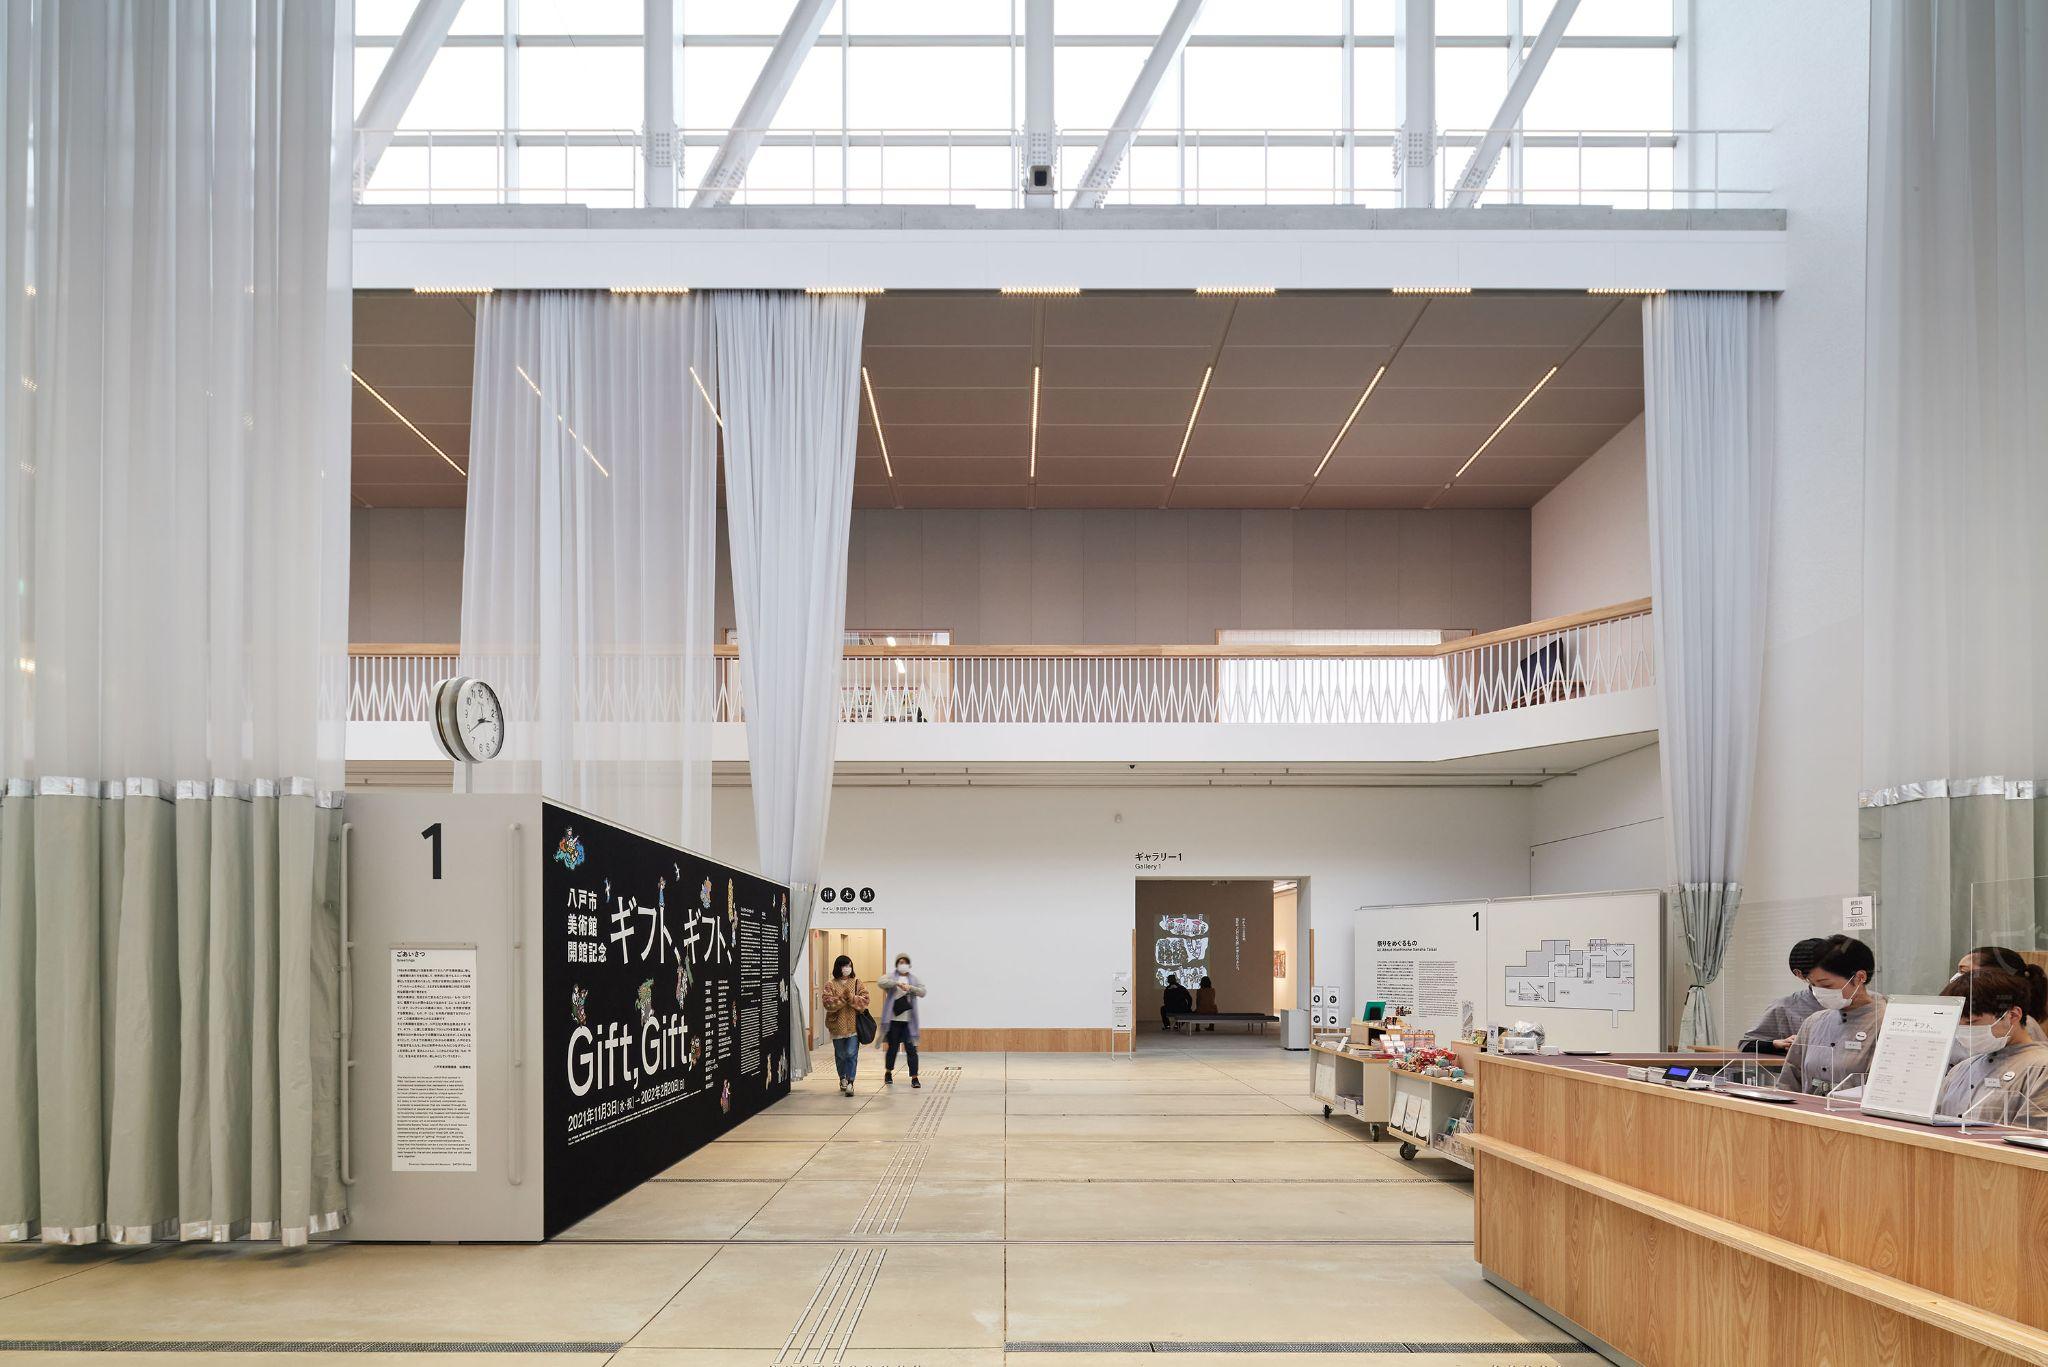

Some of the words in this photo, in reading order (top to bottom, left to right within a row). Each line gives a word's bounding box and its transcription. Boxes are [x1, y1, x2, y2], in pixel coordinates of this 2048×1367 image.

[420, 822, 442, 879] 1
[567, 887, 598, 912] 八戸市
[567, 913, 598, 938] 美術館
[1472, 911, 1480, 931] 1
[567, 940, 607, 963] 開館記念
